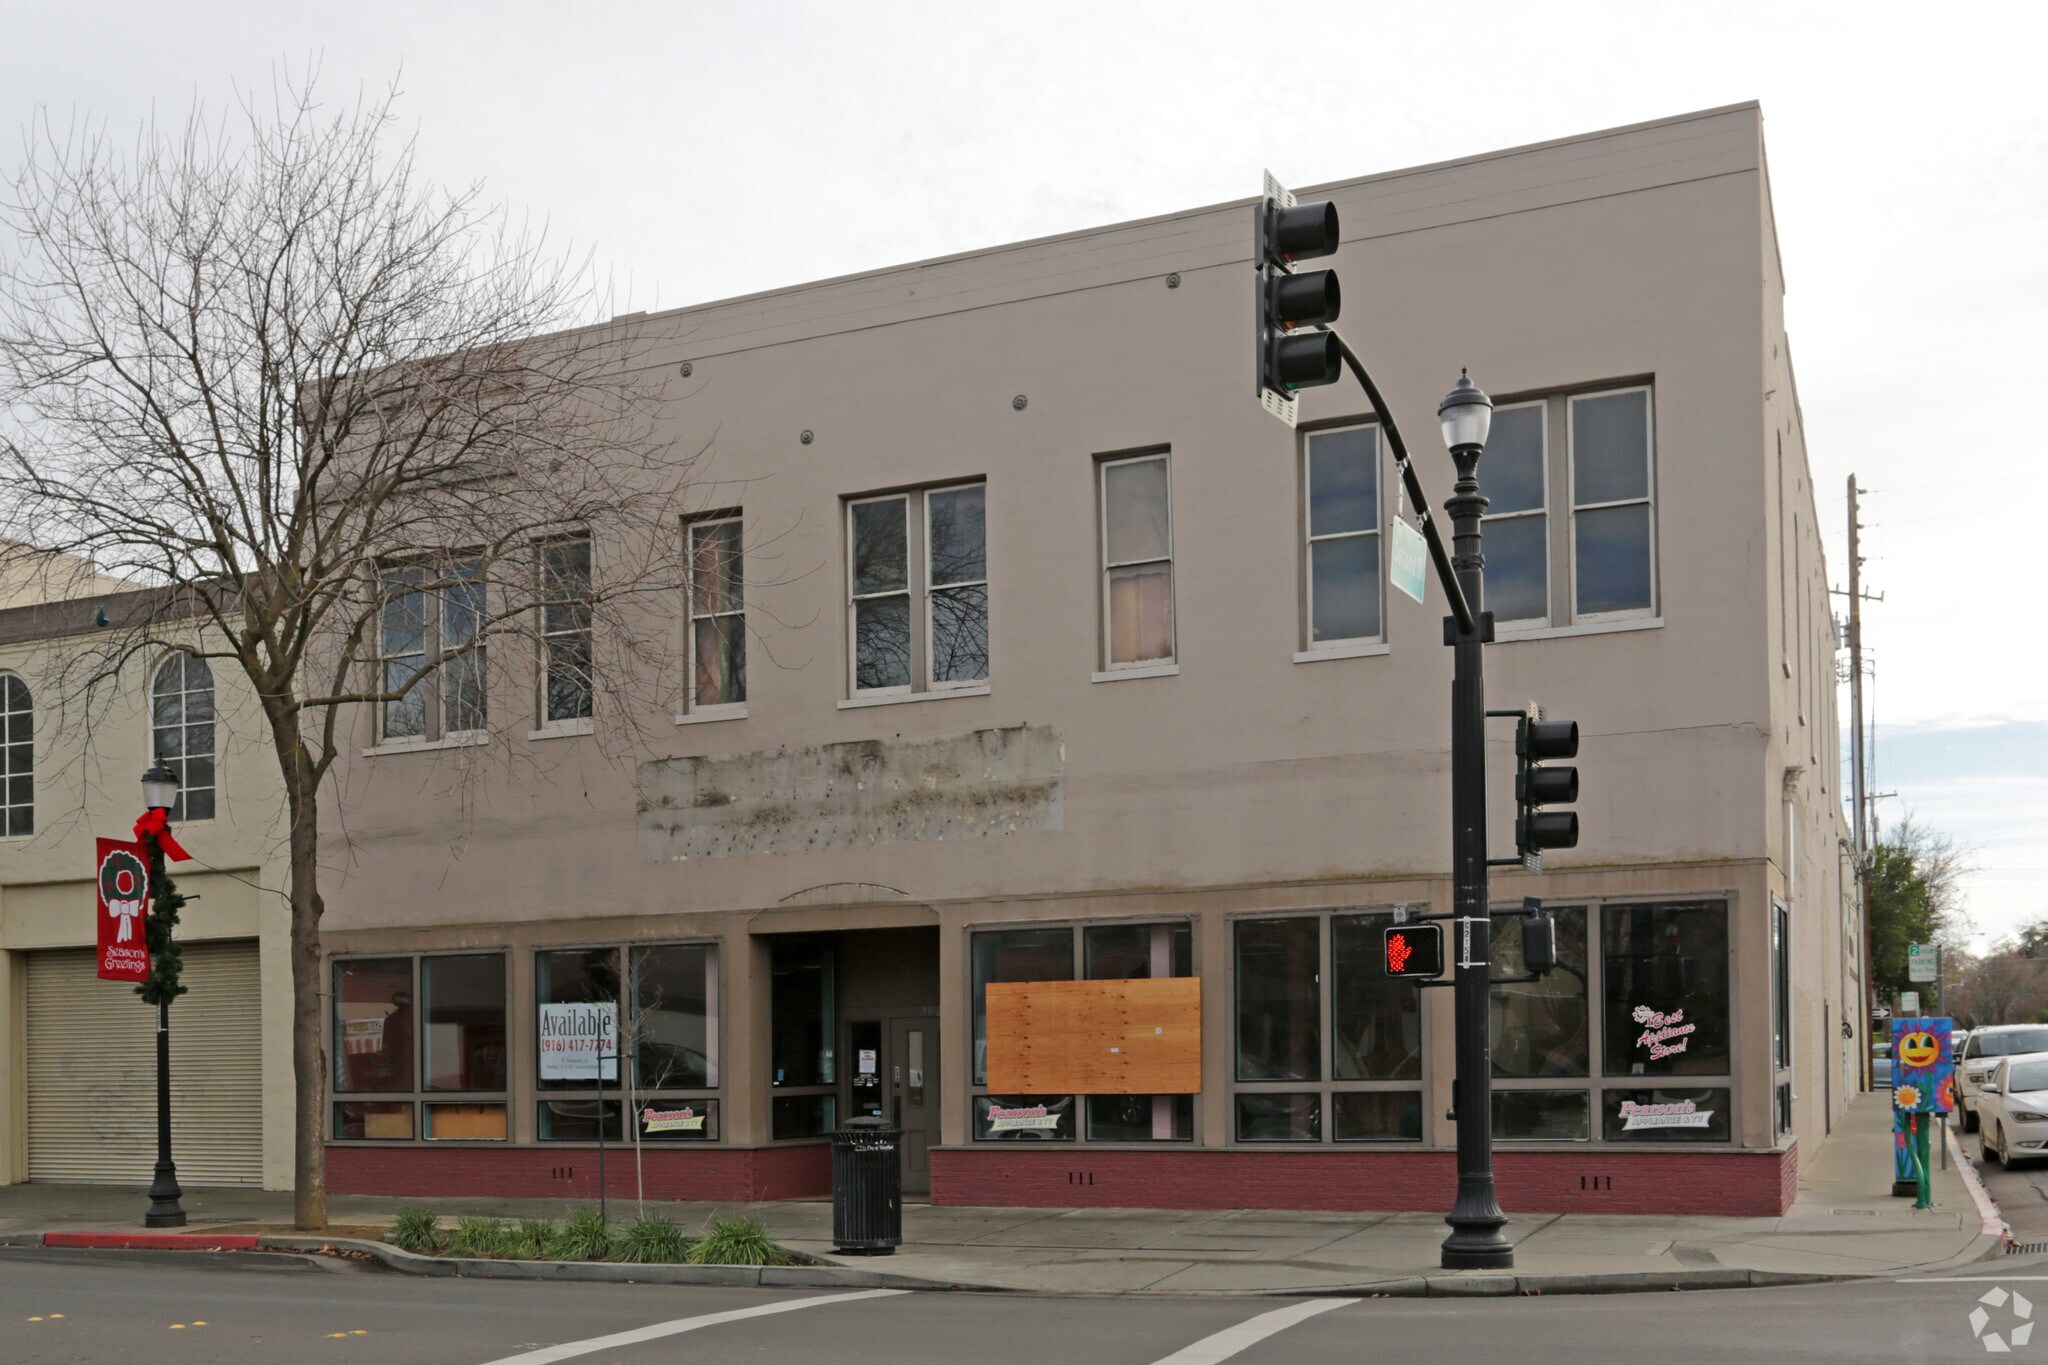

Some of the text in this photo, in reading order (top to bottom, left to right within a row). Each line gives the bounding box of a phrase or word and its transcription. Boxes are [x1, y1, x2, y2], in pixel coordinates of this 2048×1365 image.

[106, 945, 146, 960] Season's
[1911, 947, 1919, 956] 2
[104, 957, 146, 973] Greetings
[541, 1008, 611, 1037] Available
[1636, 1023, 1696, 1048] Appliance
[541, 1039, 612, 1052] (916) 417-7774
[1650, 1037, 1688, 1060] Store!
[1618, 1099, 1697, 1119] Pearson's
[1632, 1116, 1681, 1126] APPLIANCE
[1691, 1115, 1704, 1123] TV
